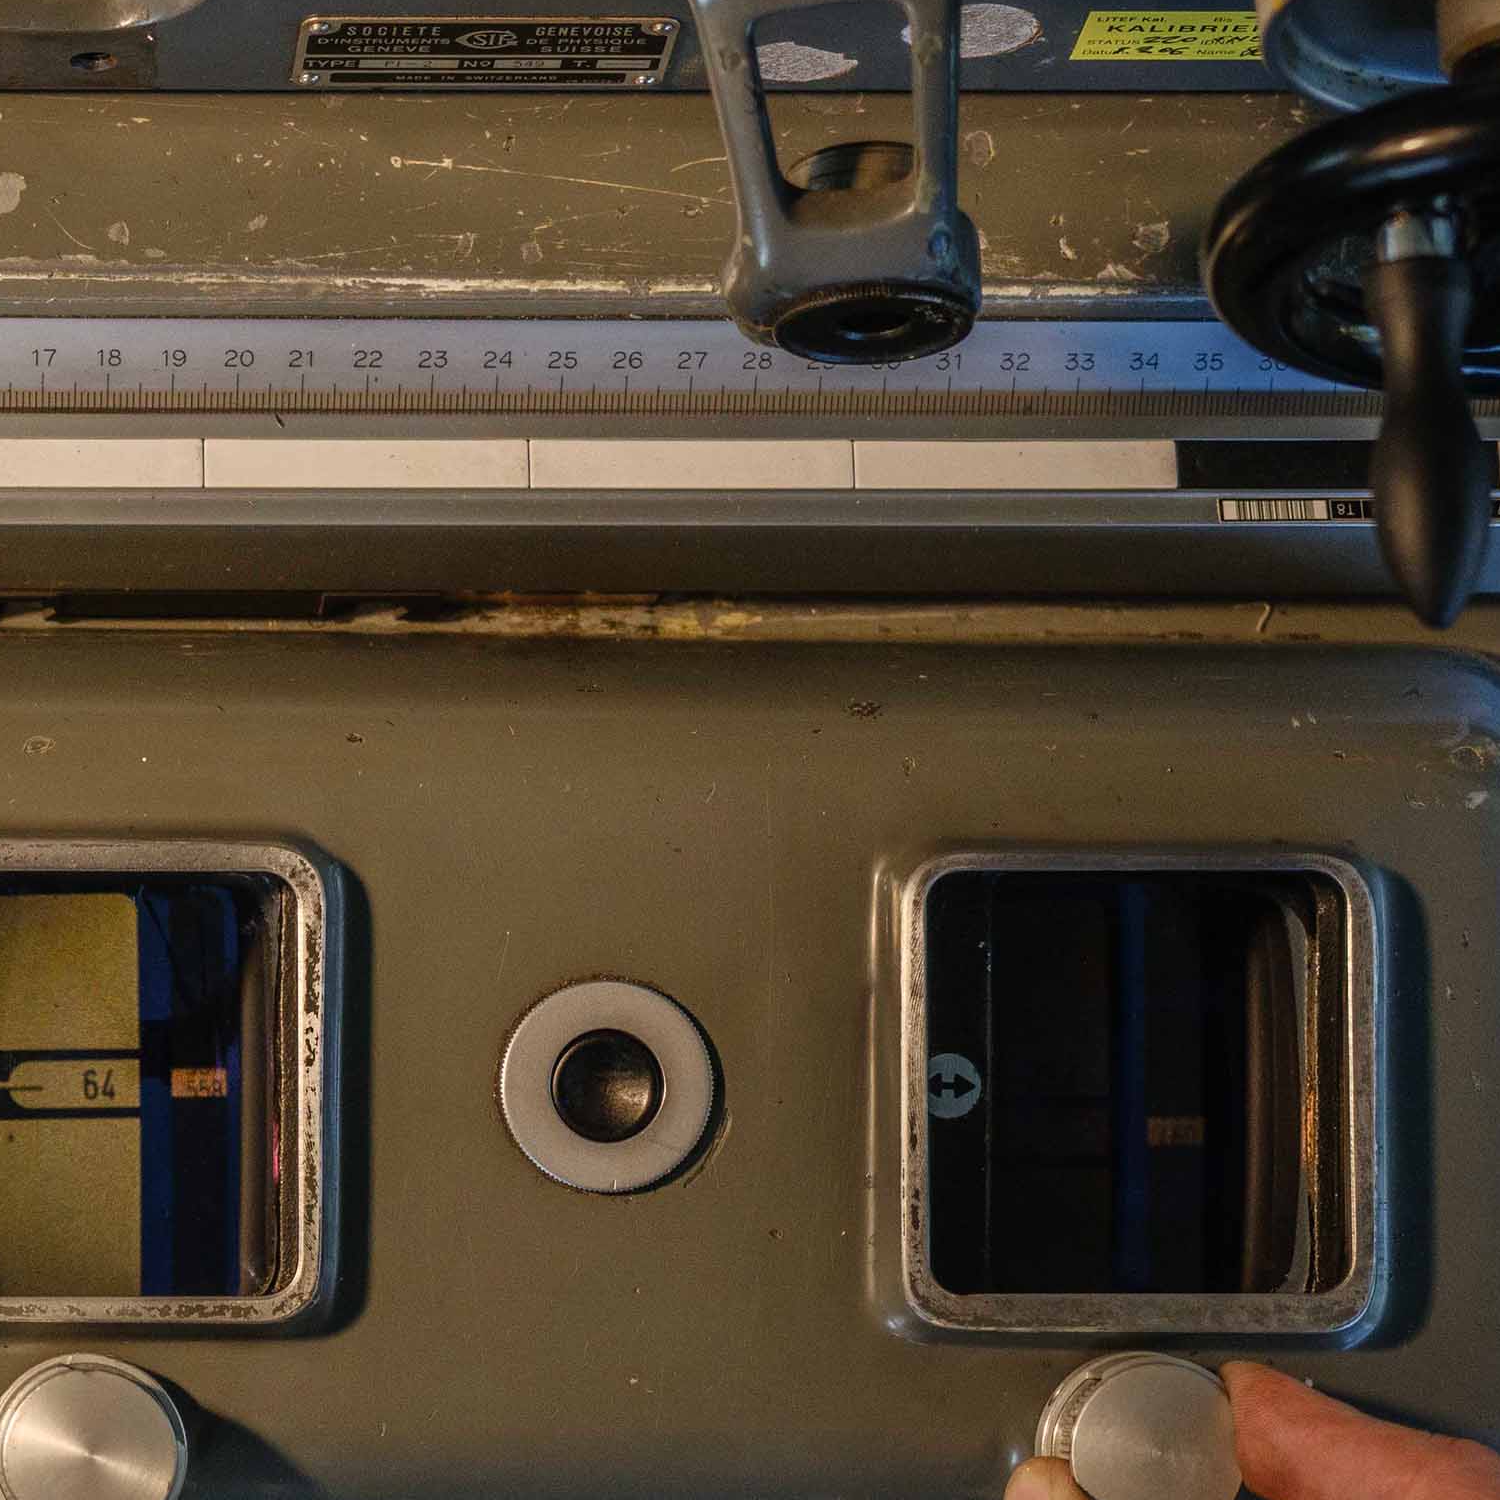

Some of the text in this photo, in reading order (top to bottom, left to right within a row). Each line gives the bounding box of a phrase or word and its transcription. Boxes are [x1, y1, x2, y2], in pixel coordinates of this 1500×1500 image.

[346, 26, 635, 38] SOCIETE GENEVOISE
[1107, 25, 1258, 33] KALIBRIE
[317, 37, 451, 46] D'INSTRUMENTS
[525, 38, 546, 46] DE
[556, 37, 647, 46] PHYSIQUE
[347, 45, 623, 54] GENEVE SUISSE
[305, 59, 357, 69] TYPE
[31, 348, 57, 367] 17
[96, 348, 123, 367] 18
[161, 349, 188, 367] 19
[223, 349, 255, 367] 20
[288, 349, 314, 368] 21
[352, 349, 384, 368] 22
[417, 350, 449, 368] 23
[482, 350, 513, 369] 24
[547, 350, 578, 369] 25
[612, 350, 644, 369] 26
[676, 350, 709, 369] 27
[741, 351, 773, 370] 28
[935, 352, 961, 371] 31
[999, 352, 1031, 371] 32
[1064, 352, 1096, 371] 33
[1129, 352, 1159, 370] 34
[1193, 352, 1225, 371] 35
[1336, 502, 1355, 515] T8
[83, 1068, 116, 1100] 64
